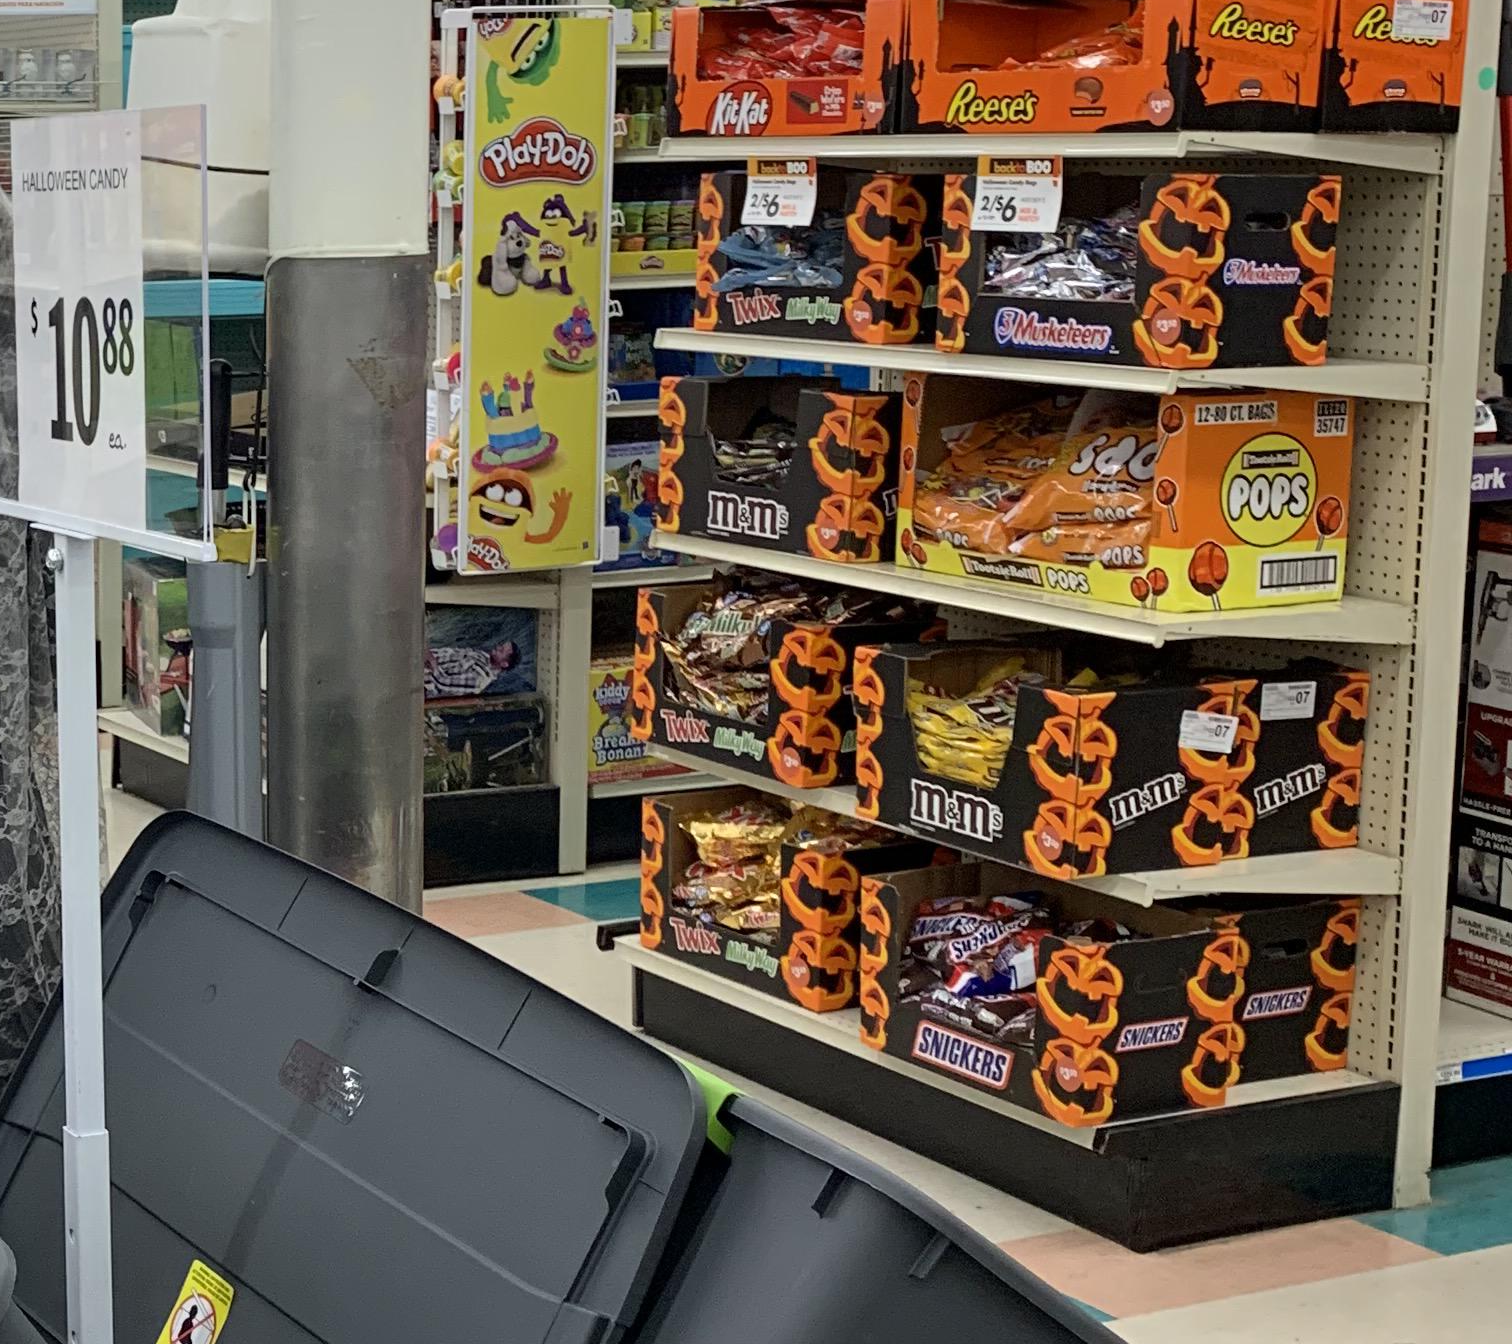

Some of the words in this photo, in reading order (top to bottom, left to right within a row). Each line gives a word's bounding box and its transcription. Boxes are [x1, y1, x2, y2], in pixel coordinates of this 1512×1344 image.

[1210, 4, 1298, 47] Reese's
[1431, 10, 1447, 24] 07
[946, 81, 1038, 125] Reese's
[484, 130, 590, 178] Play-Doh
[22, 168, 87, 193] HALLOWEEN
[89, 167, 129, 190] CANDY
[1238, 260, 1300, 285] Musketeers
[726, 288, 780, 325] Twix
[1012, 310, 1112, 350] Musketeers
[1248, 403, 1276, 420] BAGS
[1471, 467, 1507, 491] ark
[1229, 473, 1309, 521] POPS
[1046, 567, 1090, 594] POPS
[1295, 692, 1310, 704] 07
[661, 709, 711, 743] Twix
[1215, 725, 1230, 737] 07
[1475, 828, 1512, 846] TRANSPO
[1493, 840, 1512, 854] HAN
[669, 917, 722, 955] Twix
[1247, 990, 1307, 1016] SNICKERS
[1121, 1022, 1183, 1048] SNICKERS
[919, 1026, 1007, 1083] SNICKERS
